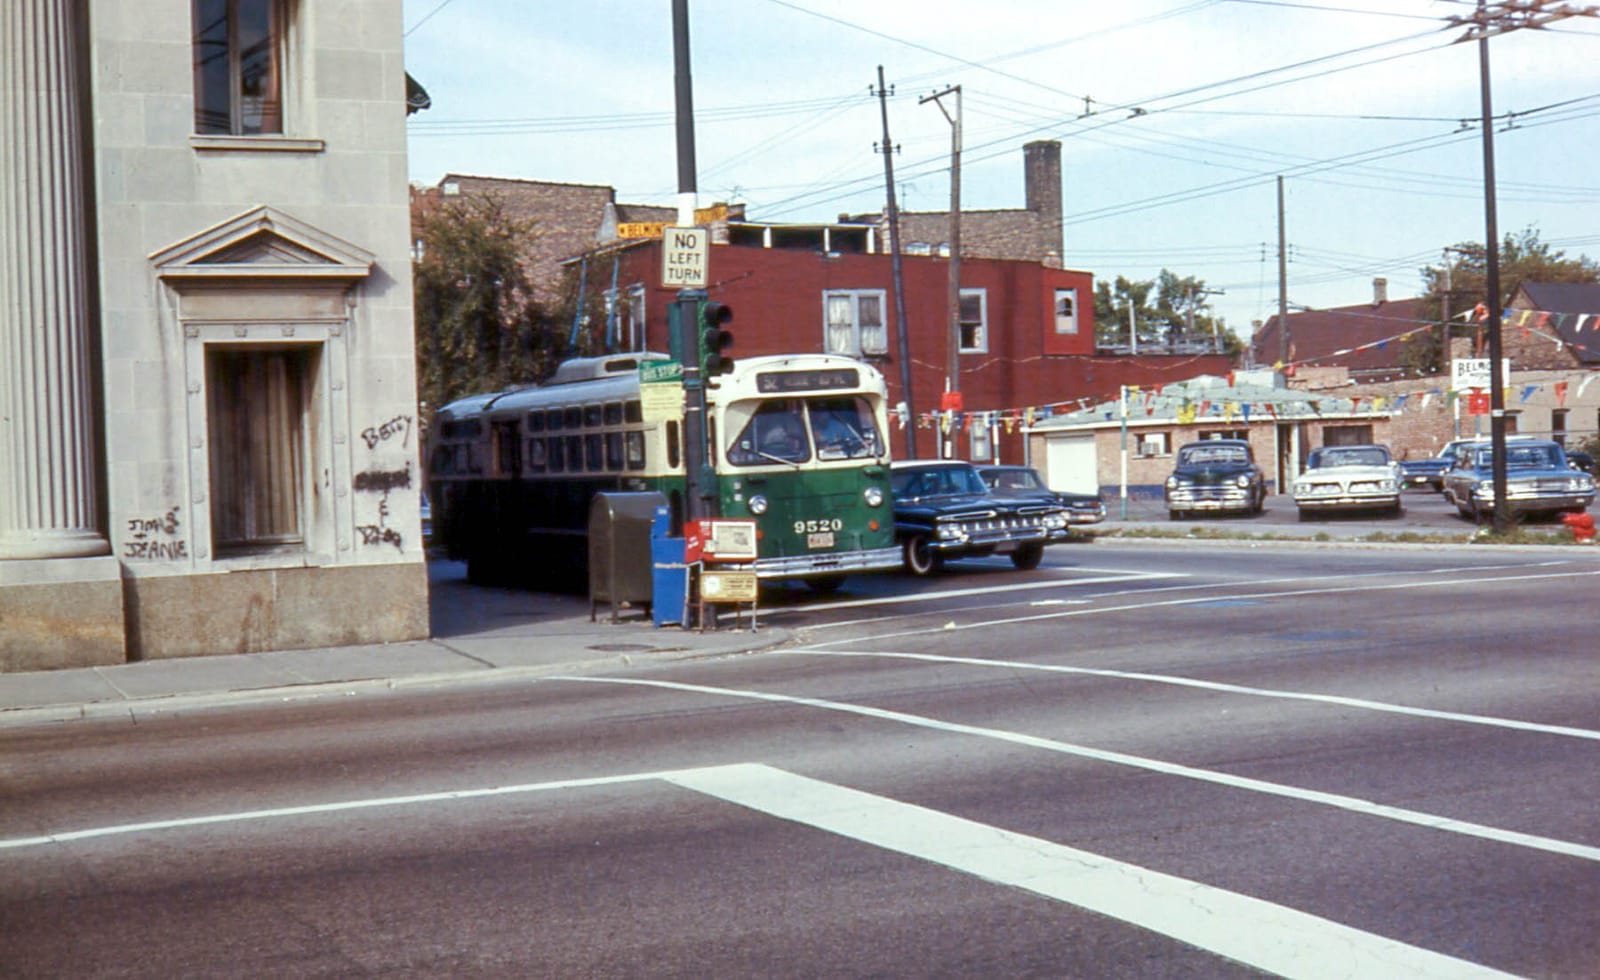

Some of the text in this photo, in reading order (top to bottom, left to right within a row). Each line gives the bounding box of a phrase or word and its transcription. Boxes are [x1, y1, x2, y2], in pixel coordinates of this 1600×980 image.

[627, 223, 668, 237] BELMON
[675, 233, 697, 249] NO
[669, 252, 702, 265] LEFT
[669, 267, 702, 280] TURN
[793, 519, 843, 534] 9520
